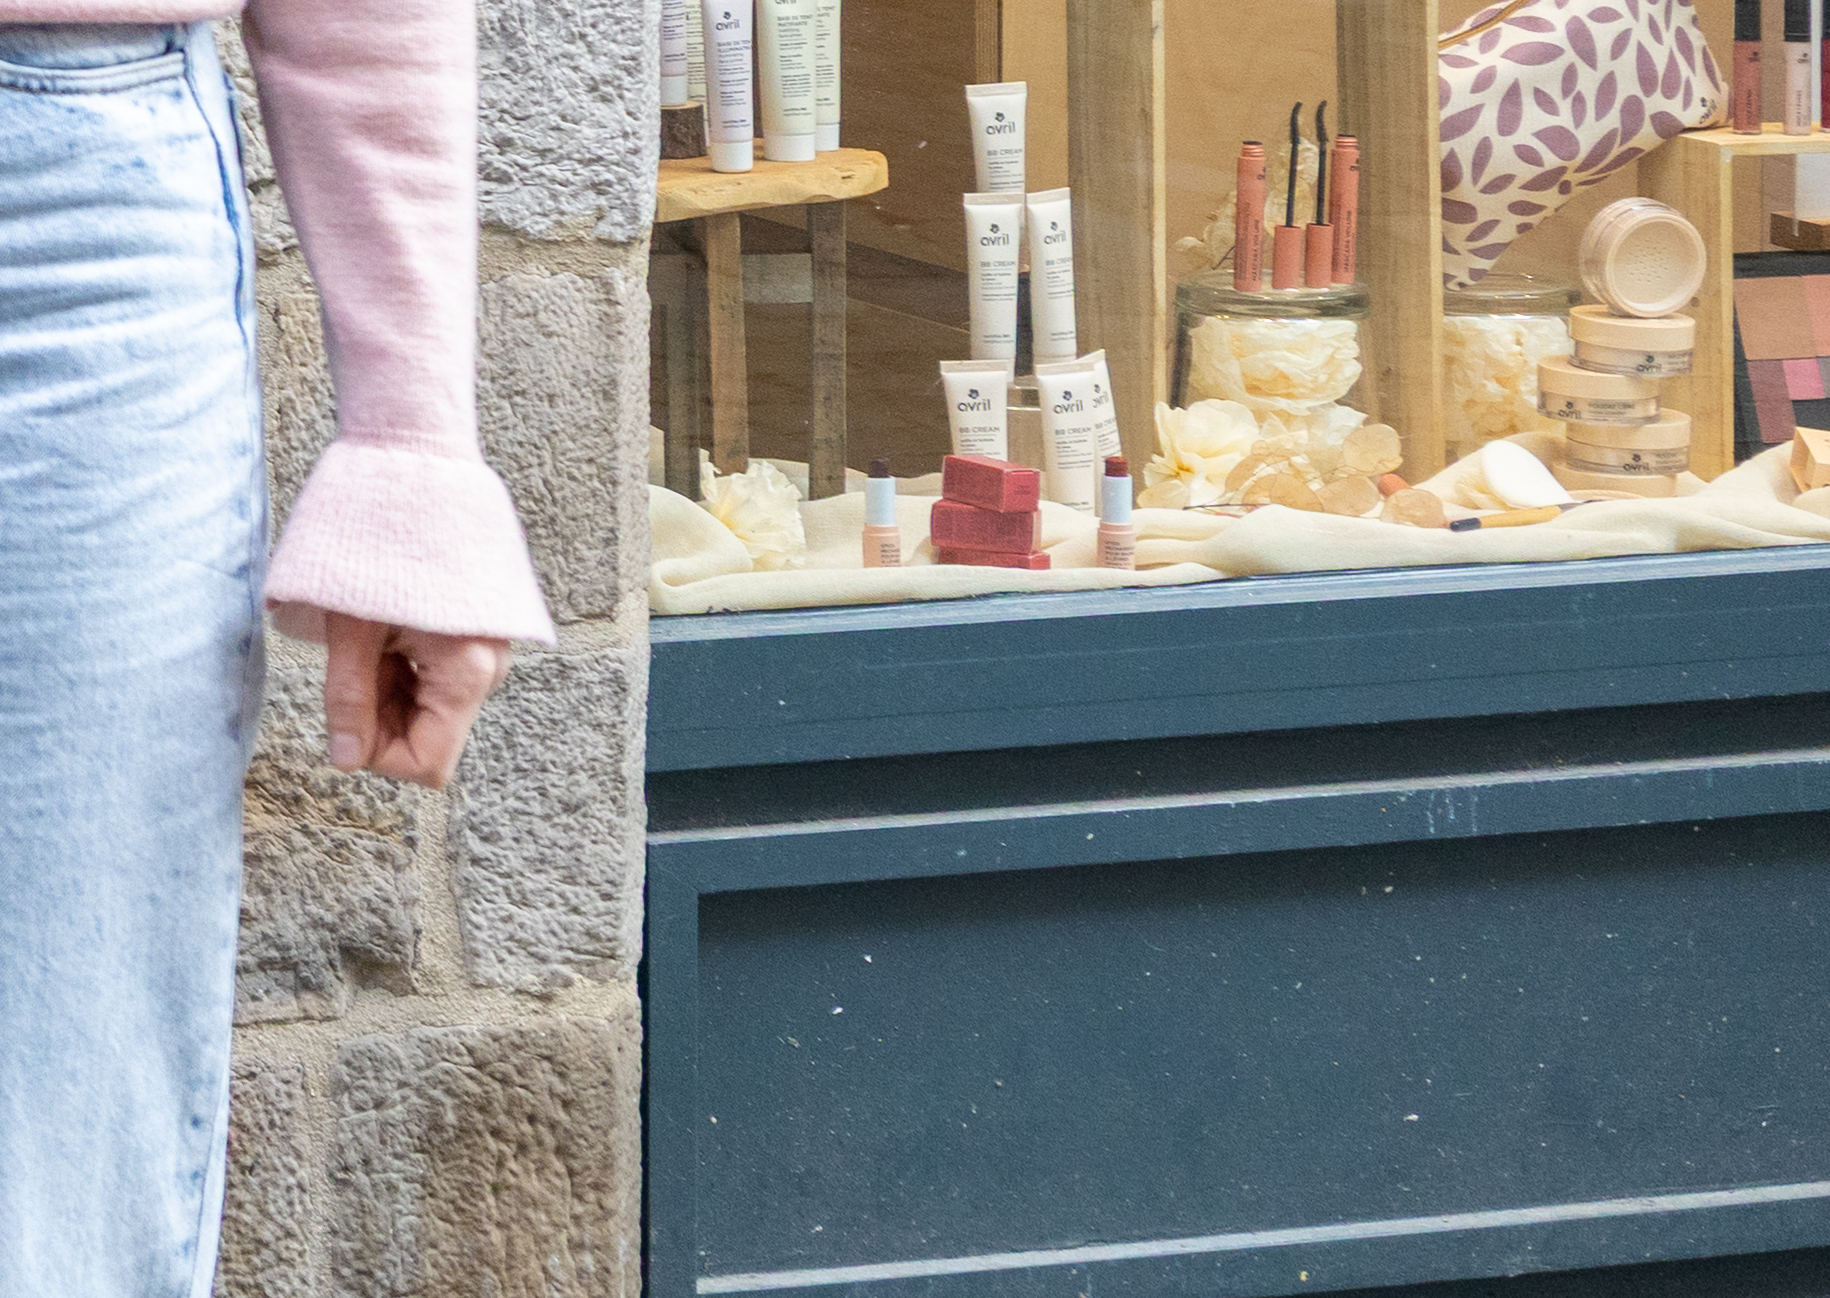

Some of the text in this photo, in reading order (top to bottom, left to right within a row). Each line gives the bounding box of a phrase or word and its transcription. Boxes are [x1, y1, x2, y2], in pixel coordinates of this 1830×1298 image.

[981, 233, 1010, 246] avril
[957, 399, 991, 412] avril
[1053, 400, 1084, 414] avril
